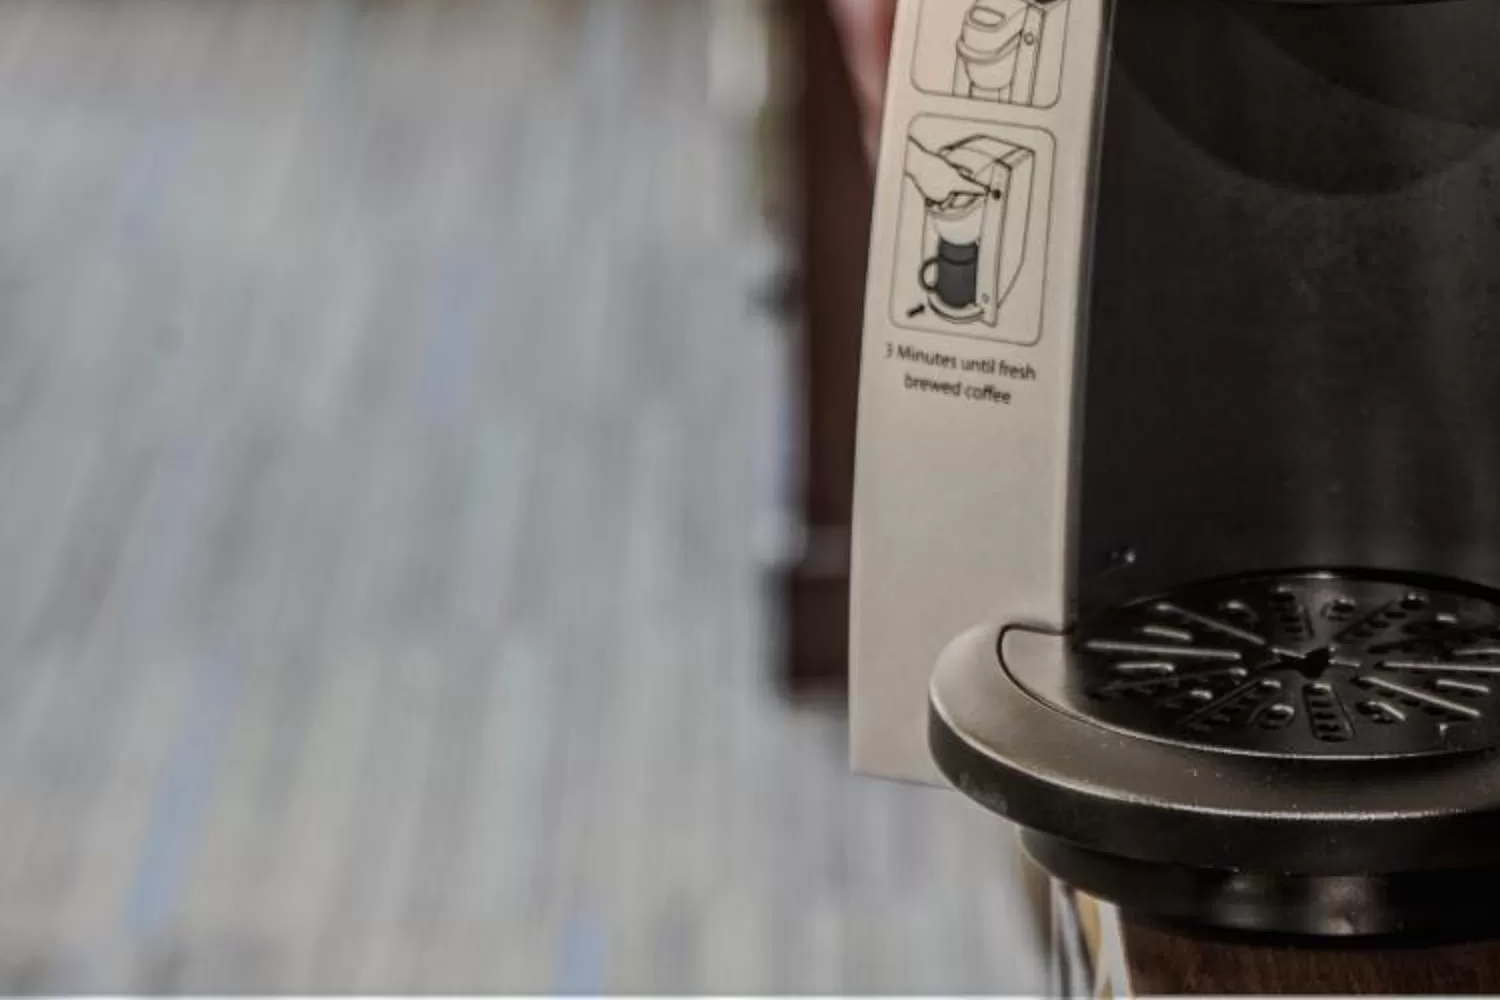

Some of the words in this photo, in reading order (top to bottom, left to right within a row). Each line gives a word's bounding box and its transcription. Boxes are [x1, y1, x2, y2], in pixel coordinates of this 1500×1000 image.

[898, 345, 956, 369] Minutes
[961, 358, 995, 374] until
[999, 360, 1036, 381] fresh
[904, 373, 961, 397] brewed
[964, 385, 1012, 405] coffee
